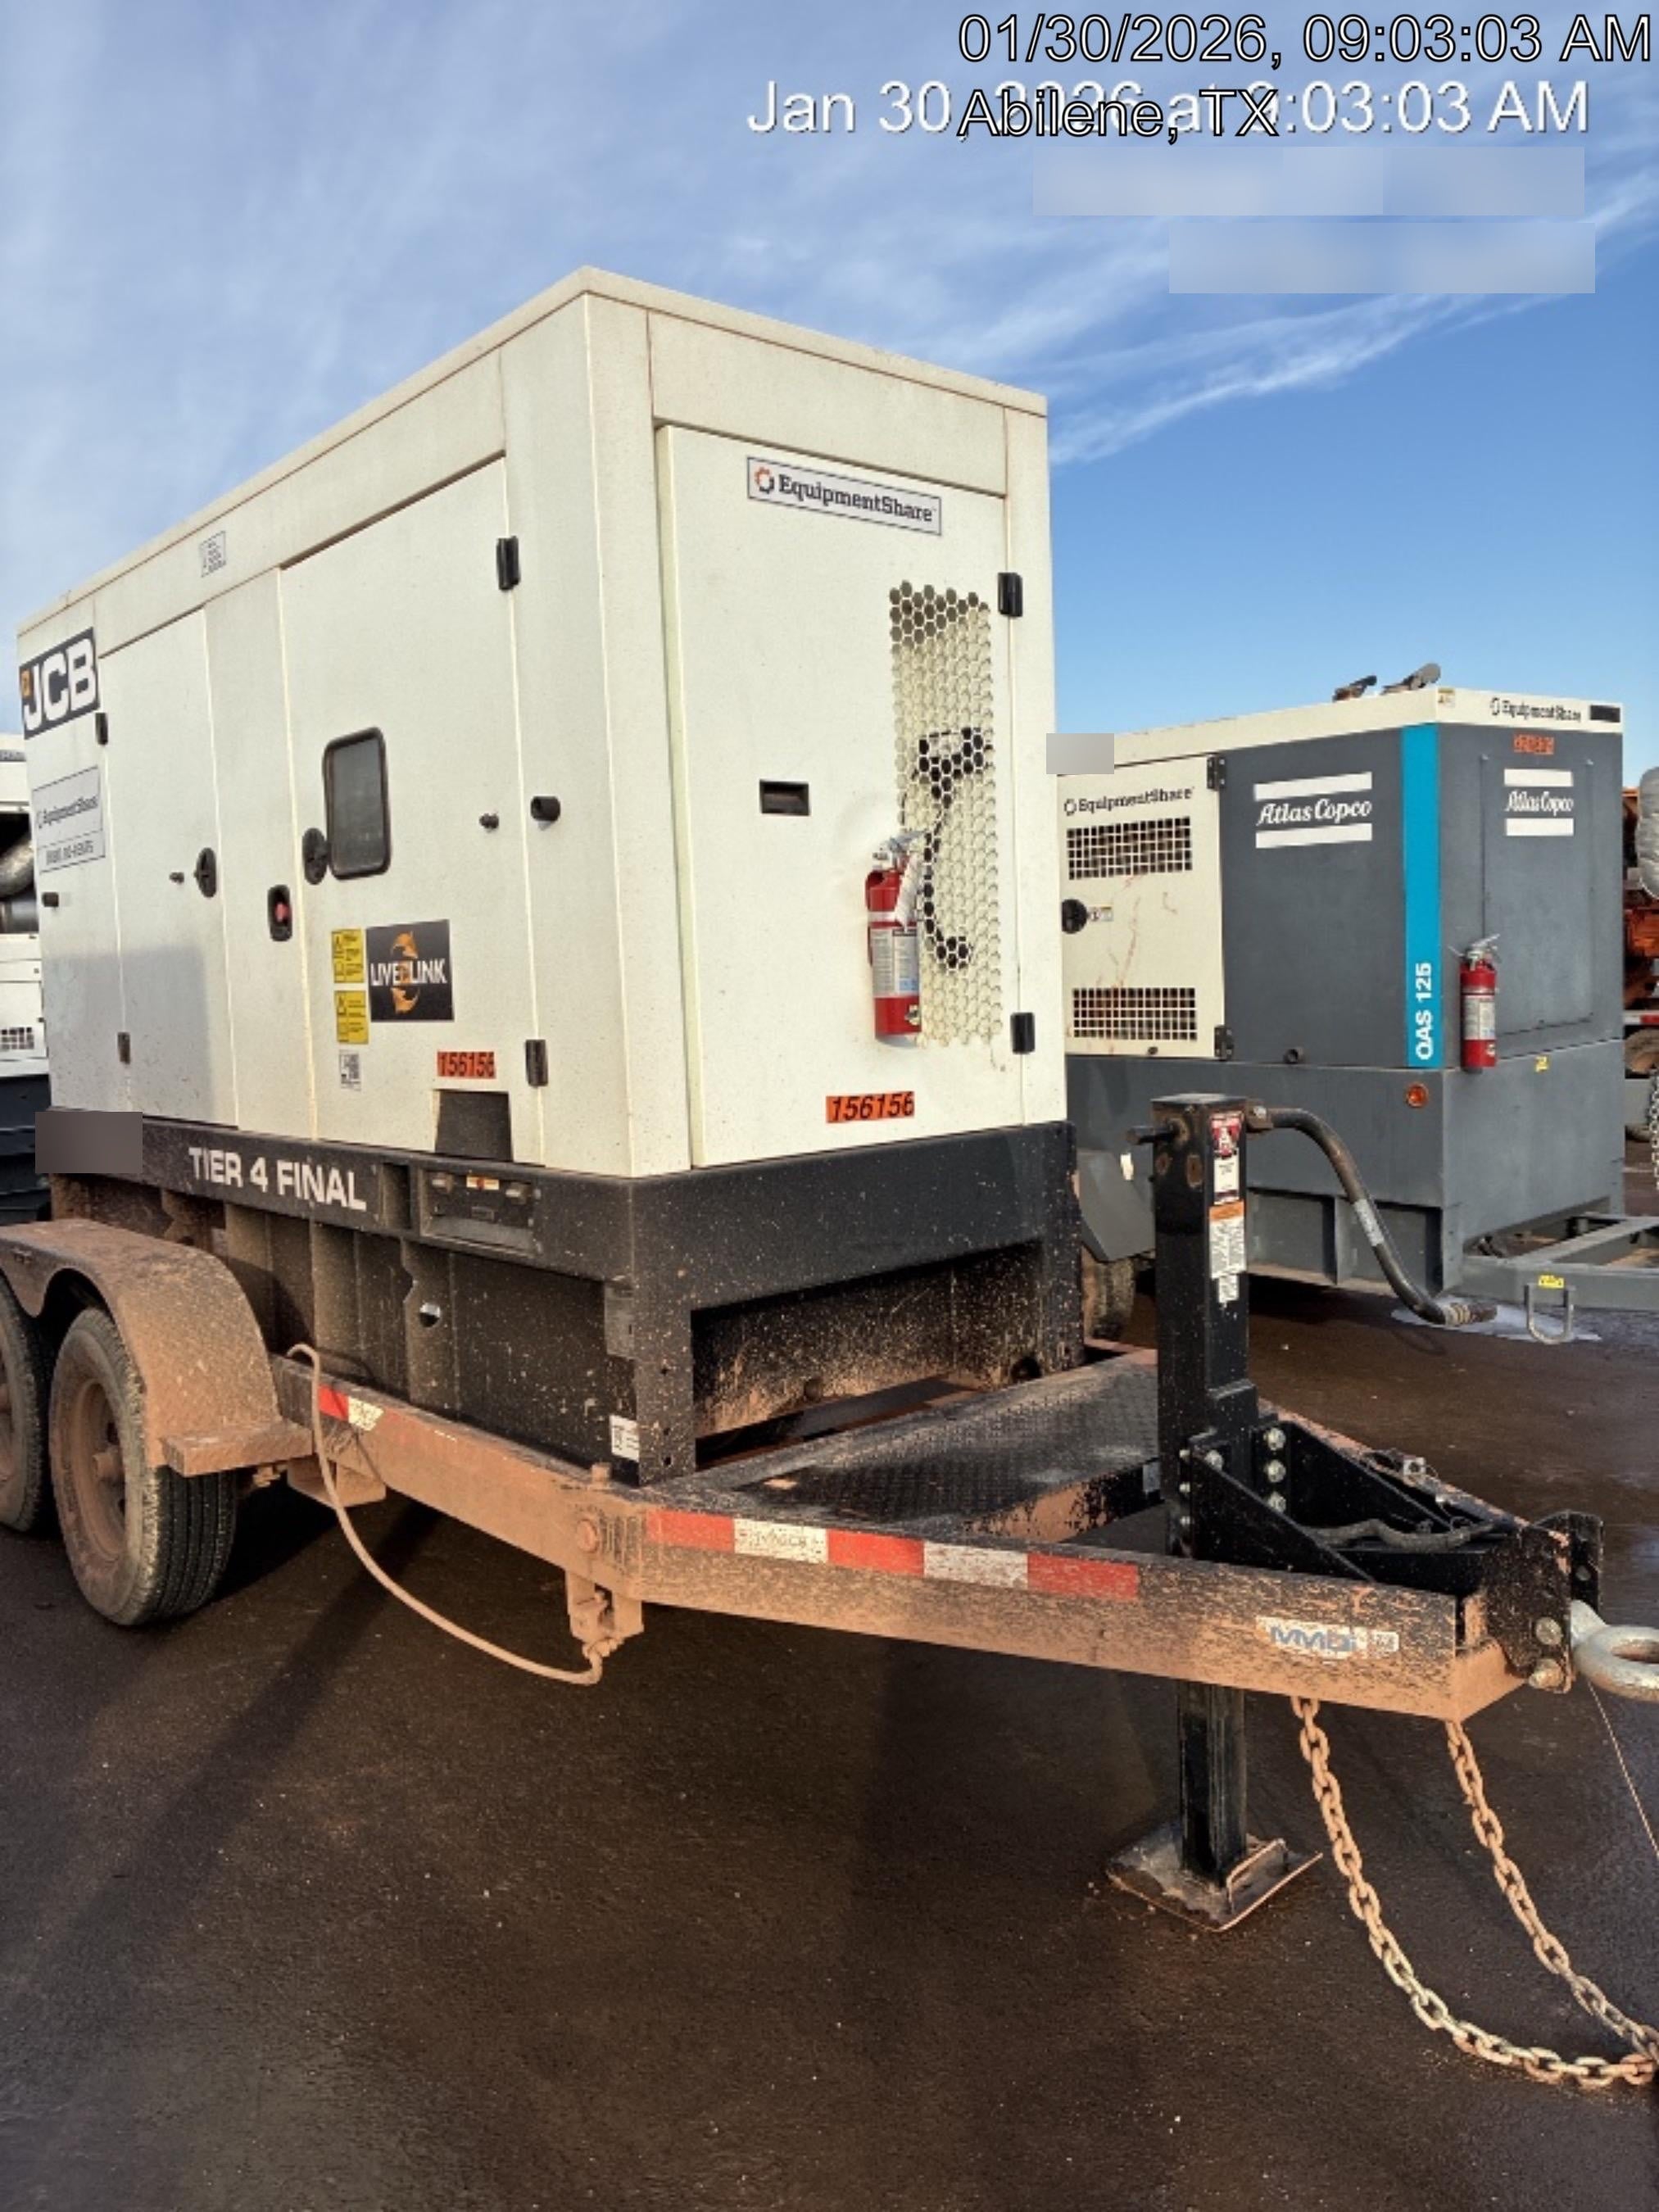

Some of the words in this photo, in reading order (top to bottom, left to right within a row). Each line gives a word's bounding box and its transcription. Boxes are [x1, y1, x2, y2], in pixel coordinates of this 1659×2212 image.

[778, 474, 932, 522] EquipmentShare
[24, 637, 97, 731] JCB
[1079, 787, 1192, 814] EquipmentShare
[1256, 803, 1312, 826] Atlas
[1314, 798, 1372, 823] Copco
[1504, 791, 1539, 812] Atlas
[1540, 791, 1574, 817] Copco
[1415, 962, 1432, 1003] 125
[832, 1090, 914, 1122] 156156
[188, 1147, 243, 1188] TIER
[249, 1157, 269, 1193] 4
[277, 1160, 367, 1212] FINAL
